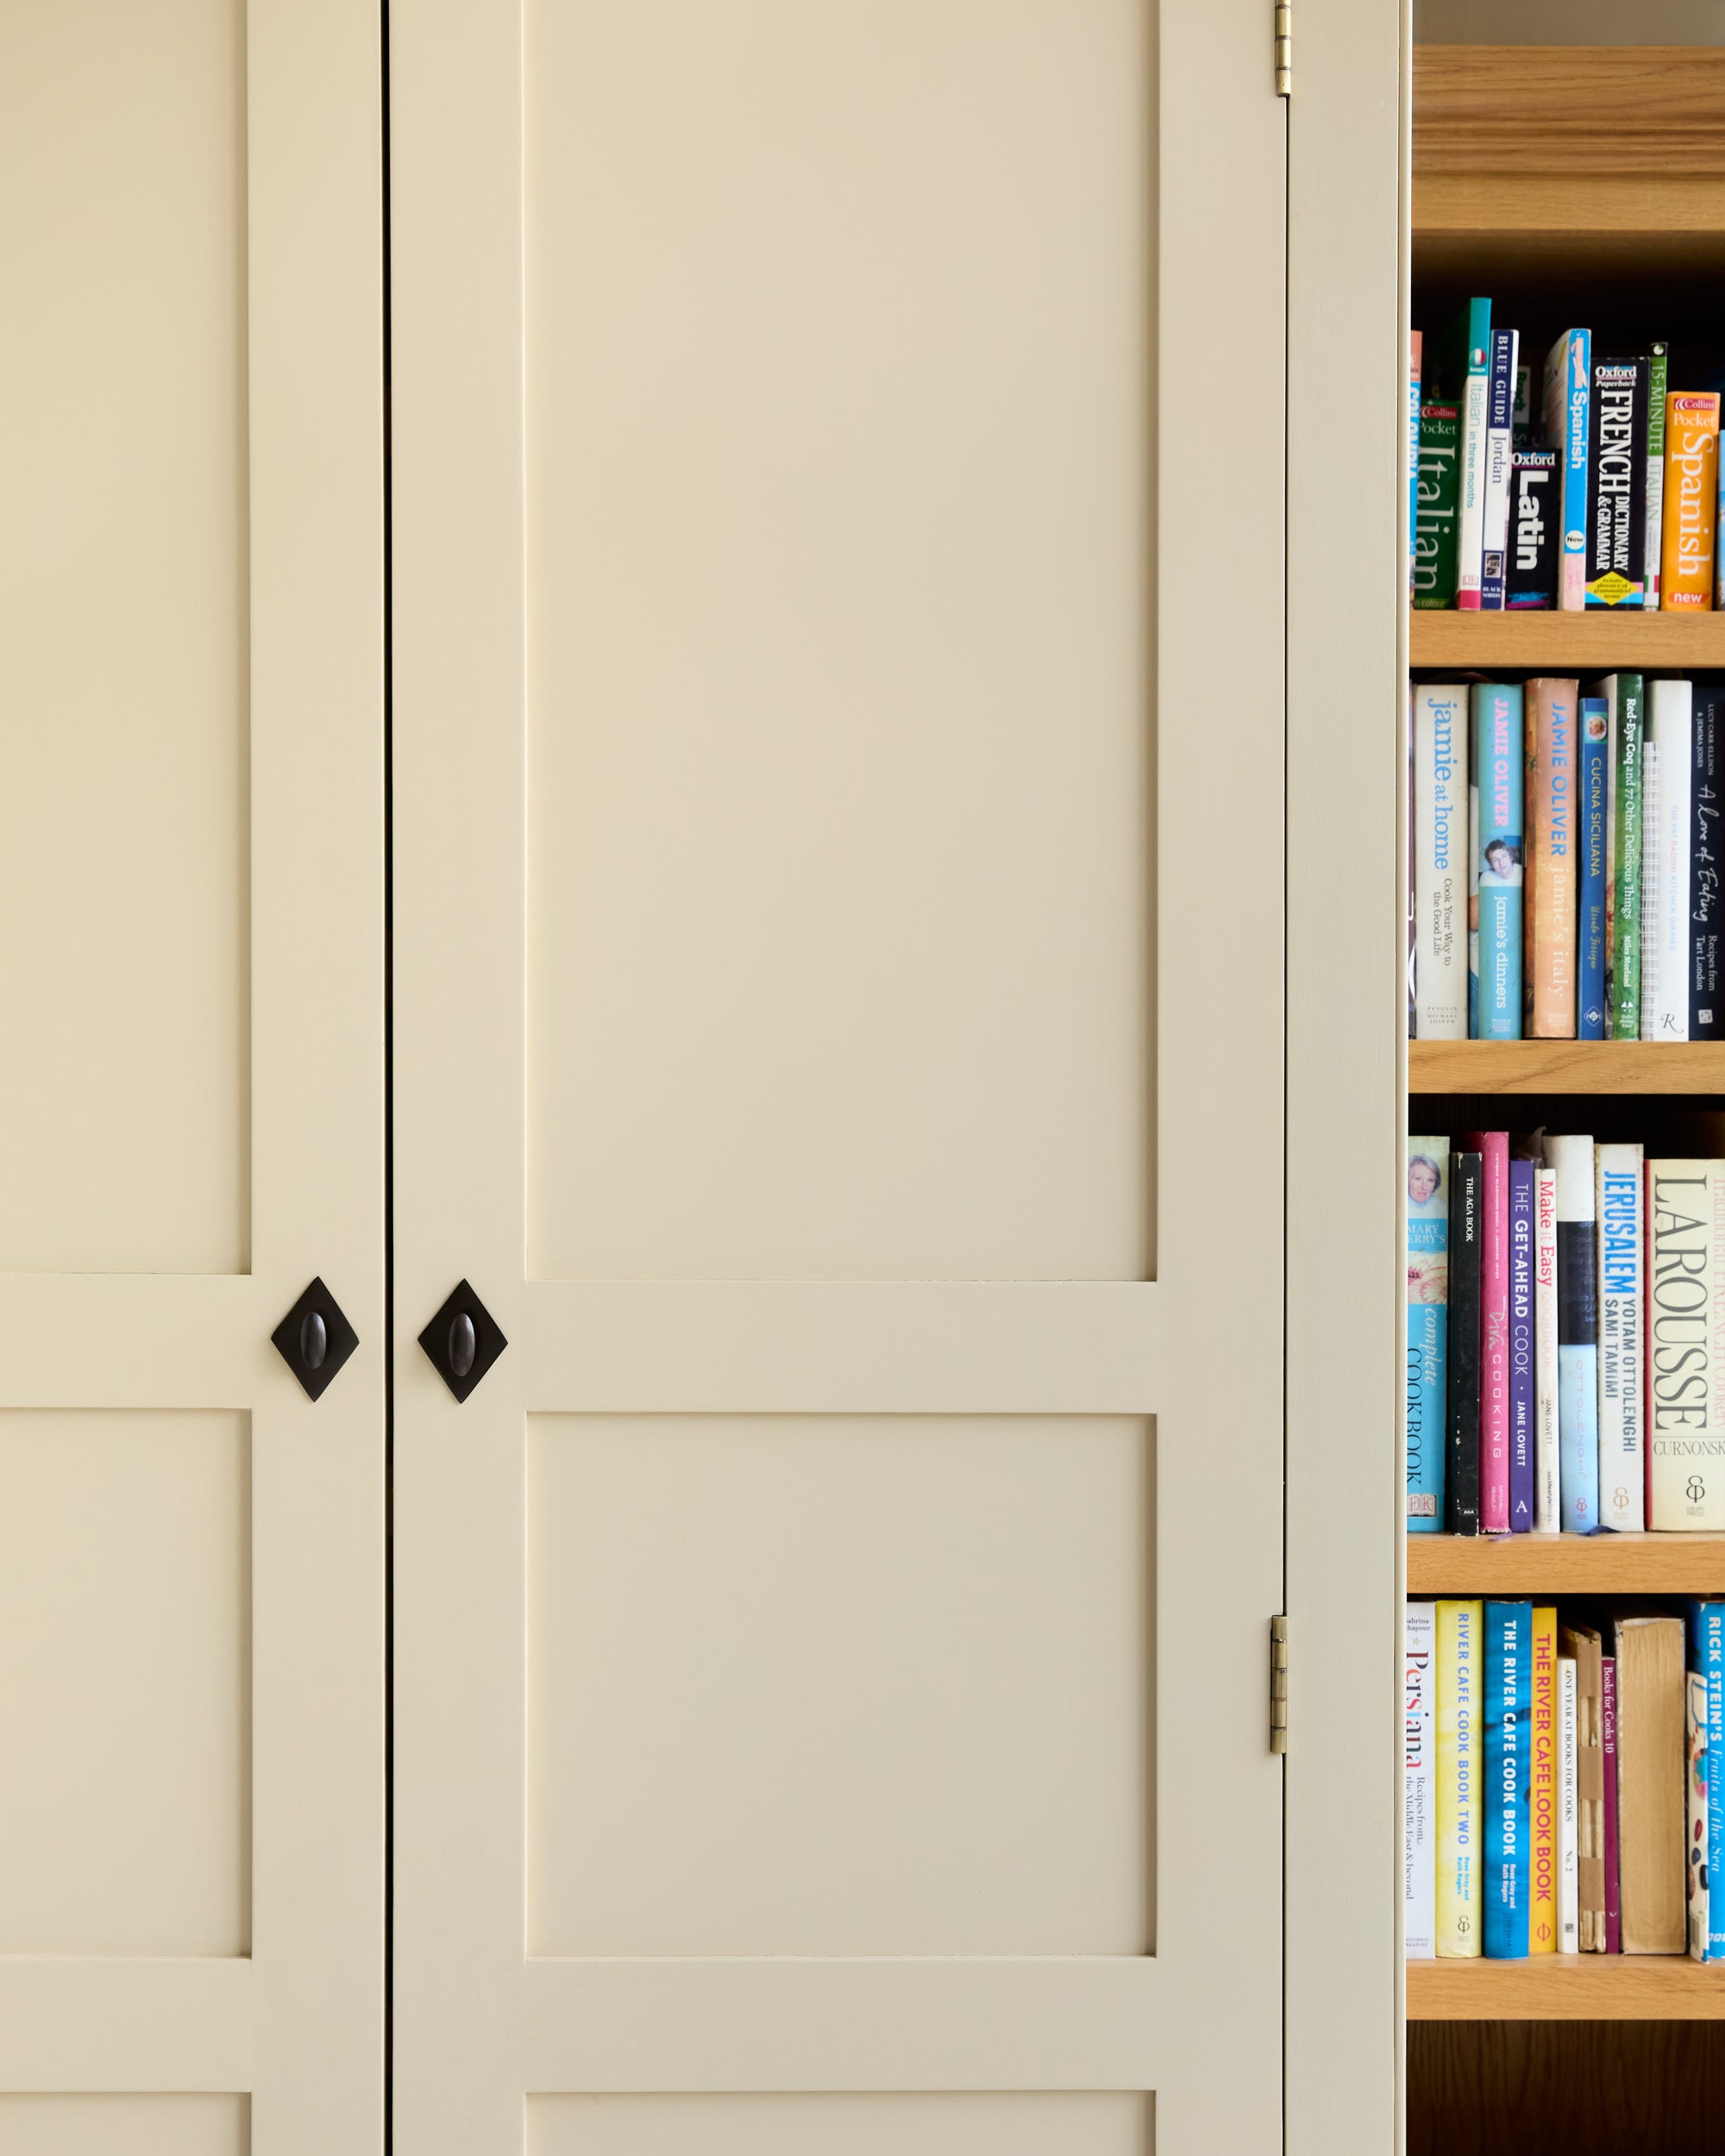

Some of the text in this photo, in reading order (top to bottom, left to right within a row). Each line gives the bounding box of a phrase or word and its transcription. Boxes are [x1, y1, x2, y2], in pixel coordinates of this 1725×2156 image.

[1494, 335, 1509, 424] BLUE GUIDE
[1595, 365, 1637, 378] Oxford
[1596, 379, 1637, 389] Paperback
[1427, 407, 1457, 419] Collins
[1469, 383, 1484, 427] Italian
[1570, 391, 1588, 469] Spanish
[1648, 365, 1665, 451] 15-MINUTE
[1673, 412, 1716, 428] Pocket
[1684, 398, 1716, 411] Collins
[1468, 443, 1477, 469] three
[1469, 431, 1477, 441] in
[1491, 436, 1507, 484] Jordan
[1512, 452, 1555, 467] Oxford
[1598, 389, 1634, 494] FRENCH
[1414, 445, 1456, 590] Italian
[1466, 472, 1475, 509] months
[1646, 464, 1661, 521] ITALIAN
[1672, 431, 1715, 578] Spanish
[1516, 470, 1549, 570] Latin
[1566, 535, 1584, 543] New
[1614, 495, 1630, 571] DICTIONARY
[1422, 598, 1446, 608] colour
[1673, 592, 1703, 604] new
[1427, 698, 1458, 870] jamie at home
[1494, 697, 1509, 828] JAMIE OLIVER
[1551, 702, 1567, 856] JAMIE OLIVER
[1590, 757, 1602, 877] CUCINA SICILIANA
[1621, 697, 1638, 919] Red-Eye Coq and 77 Other Delicious Things
[1692, 784, 1718, 922] A of Eating
[1433, 908, 1442, 936] Good
[1443, 878, 1453, 967] Cook Your Way to
[1493, 895, 1509, 949] jamie's
[1549, 864, 1569, 941] jamie's
[1433, 936, 1442, 957] Life
[1548, 950, 1570, 998] italy
[1623, 935, 1632, 988] Miles Morland
[1697, 935, 1706, 991] Tart London
[1707, 935, 1718, 992] Recipes from
[1496, 952, 1509, 1010] dinners
[1408, 1224, 1440, 1234] MARY
[1465, 1176, 1474, 1242] THE AGA BOOK
[1540, 1180, 1555, 1229] Make
[1603, 1170, 1637, 1294] JERUSALEM
[1537, 1244, 1555, 1288] Easy
[1515, 1183, 1529, 1467] THE GET-AHEAD COOK JANE LOVETT
[1653, 1174, 1709, 1430] LAROUSSE
[1419, 1307, 1442, 1387] complete
[1605, 1299, 1619, 1399] SAMI TAMIMI
[1622, 1298, 1637, 1452] YOTAM OTTOLENGHI
[1492, 1354, 1502, 1458] COOKING
[1408, 1495, 1435, 1513] DK
[1565, 1670, 1573, 1691] ONE
[1565, 1693, 1573, 1717] YEAR
[1407, 1651, 1430, 1769] Persiana
[1457, 1613, 1470, 1846] RIVER CAFE COOK BOOK TWO
[1502, 1620, 1517, 1856] THE RIVER CAFE COOK BOOK
[1565, 1719, 1573, 1731] AT
[1603, 1666, 1615, 1754] Books for Cooks 10
[1536, 1633, 1552, 1902] THE RIVER CAFE LOOK BOOK
[1565, 1733, 1573, 1766] BOOKS
[1708, 1616, 1724, 1872] RICK STEIN'S Fruits of the Sea
[1565, 1768, 1573, 1788] FOR
[1565, 1789, 1573, 1822] COOKS
[1414, 1776, 1427, 1845] Recipes from
[1565, 1850, 1573, 1865] No.
